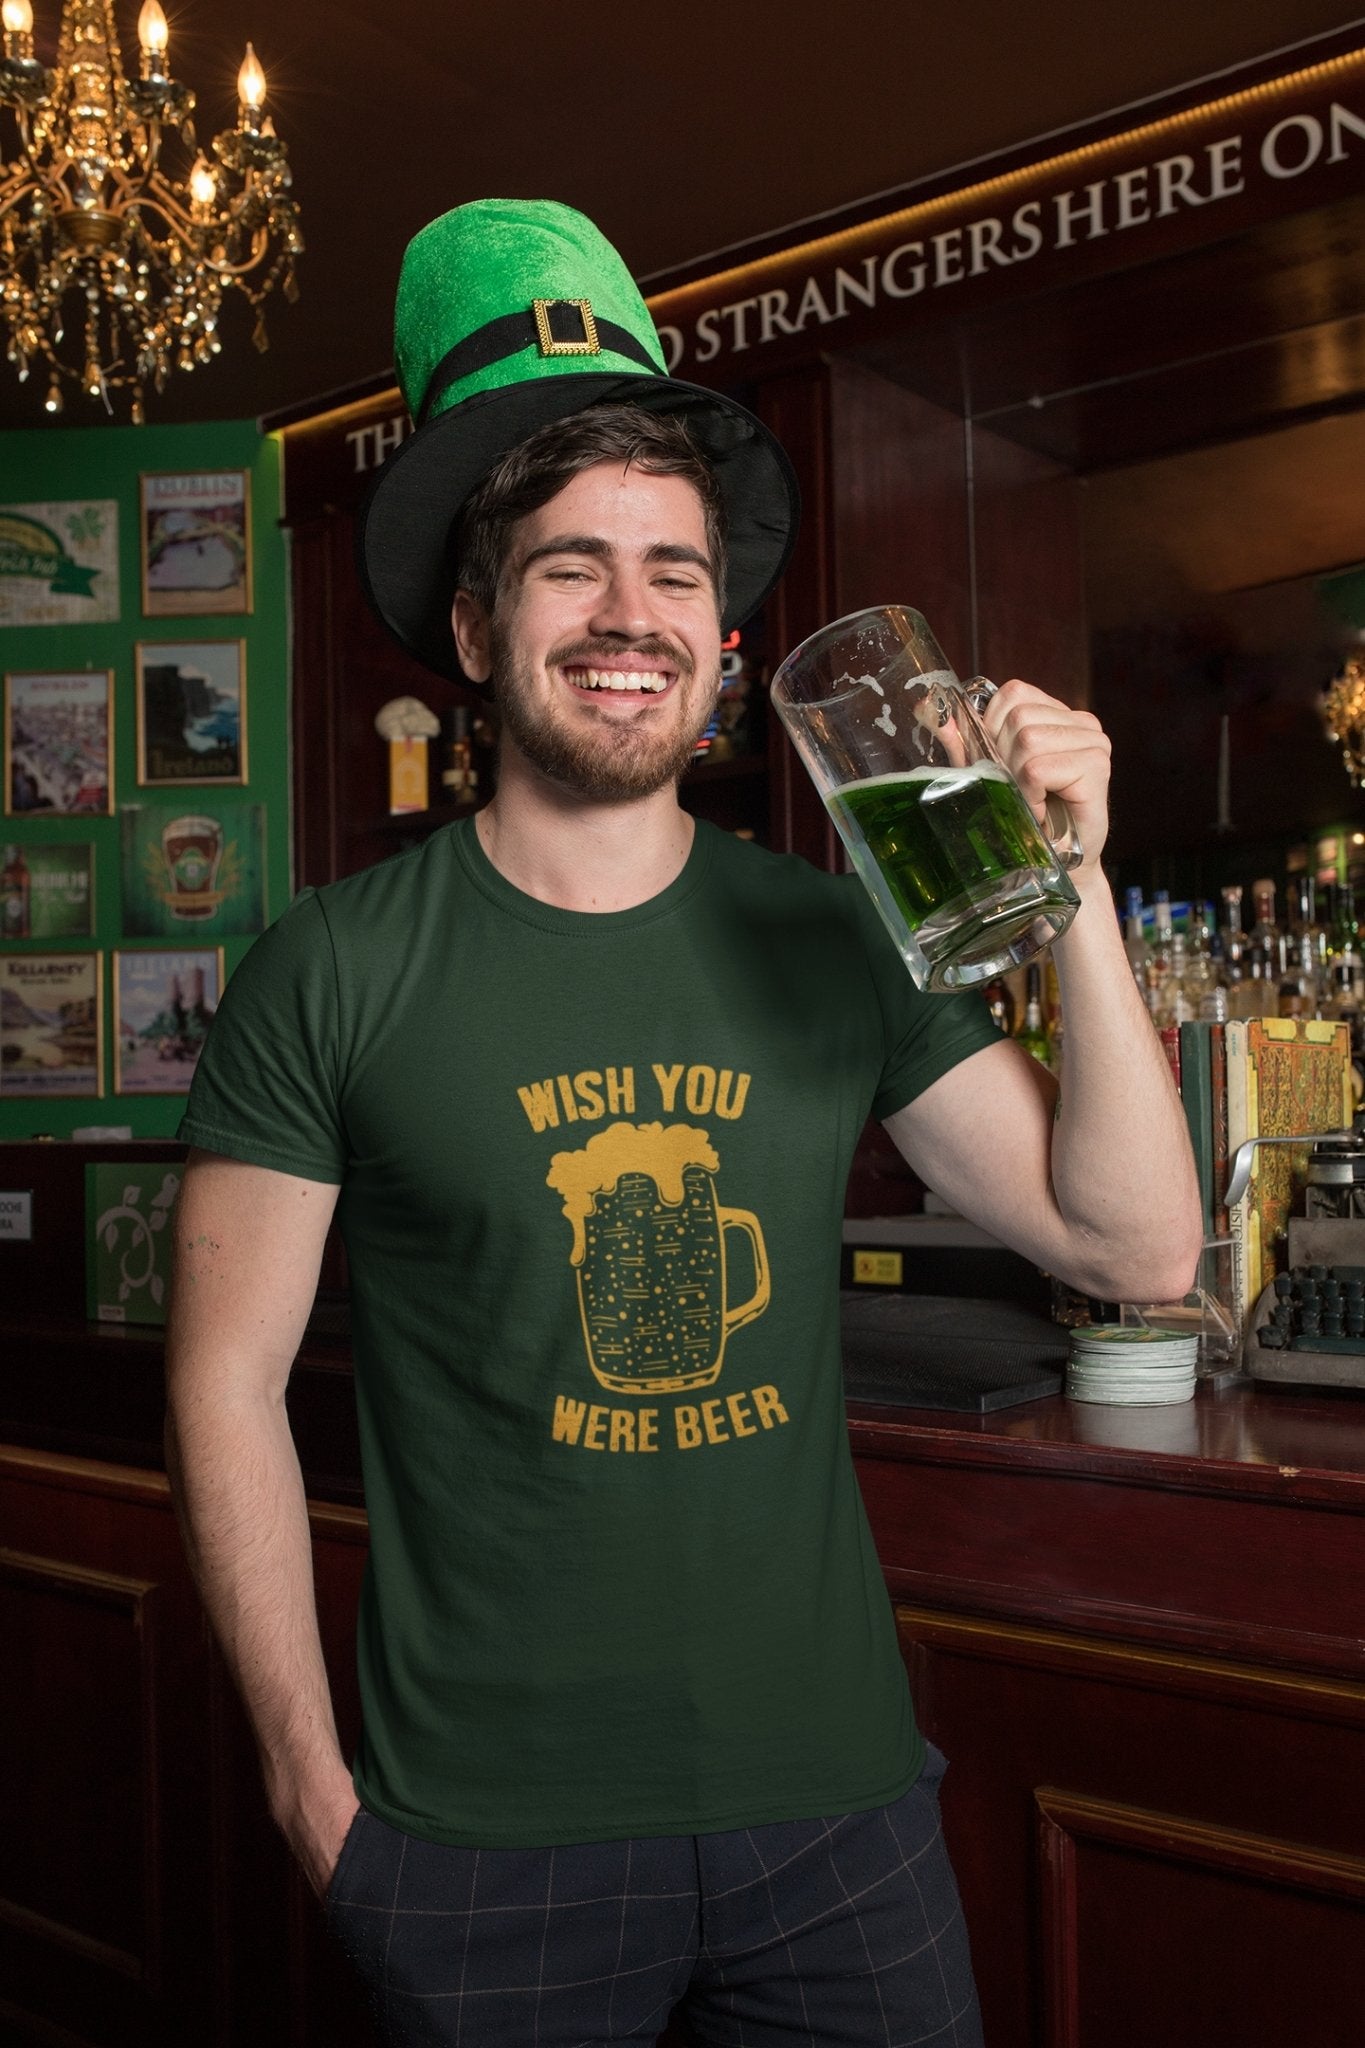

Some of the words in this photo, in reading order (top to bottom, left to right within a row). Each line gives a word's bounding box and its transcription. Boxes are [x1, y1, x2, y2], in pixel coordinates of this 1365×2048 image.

[344, 415, 415, 473] TH
[695, 202, 1043, 362] STRANGERS
[1052, 136, 1246, 248] HERE
[516, 1066, 636, 1133] WISH
[651, 1063, 752, 1121] YOU
[552, 1395, 659, 1452] WERE
[674, 1384, 789, 1449] BEER
